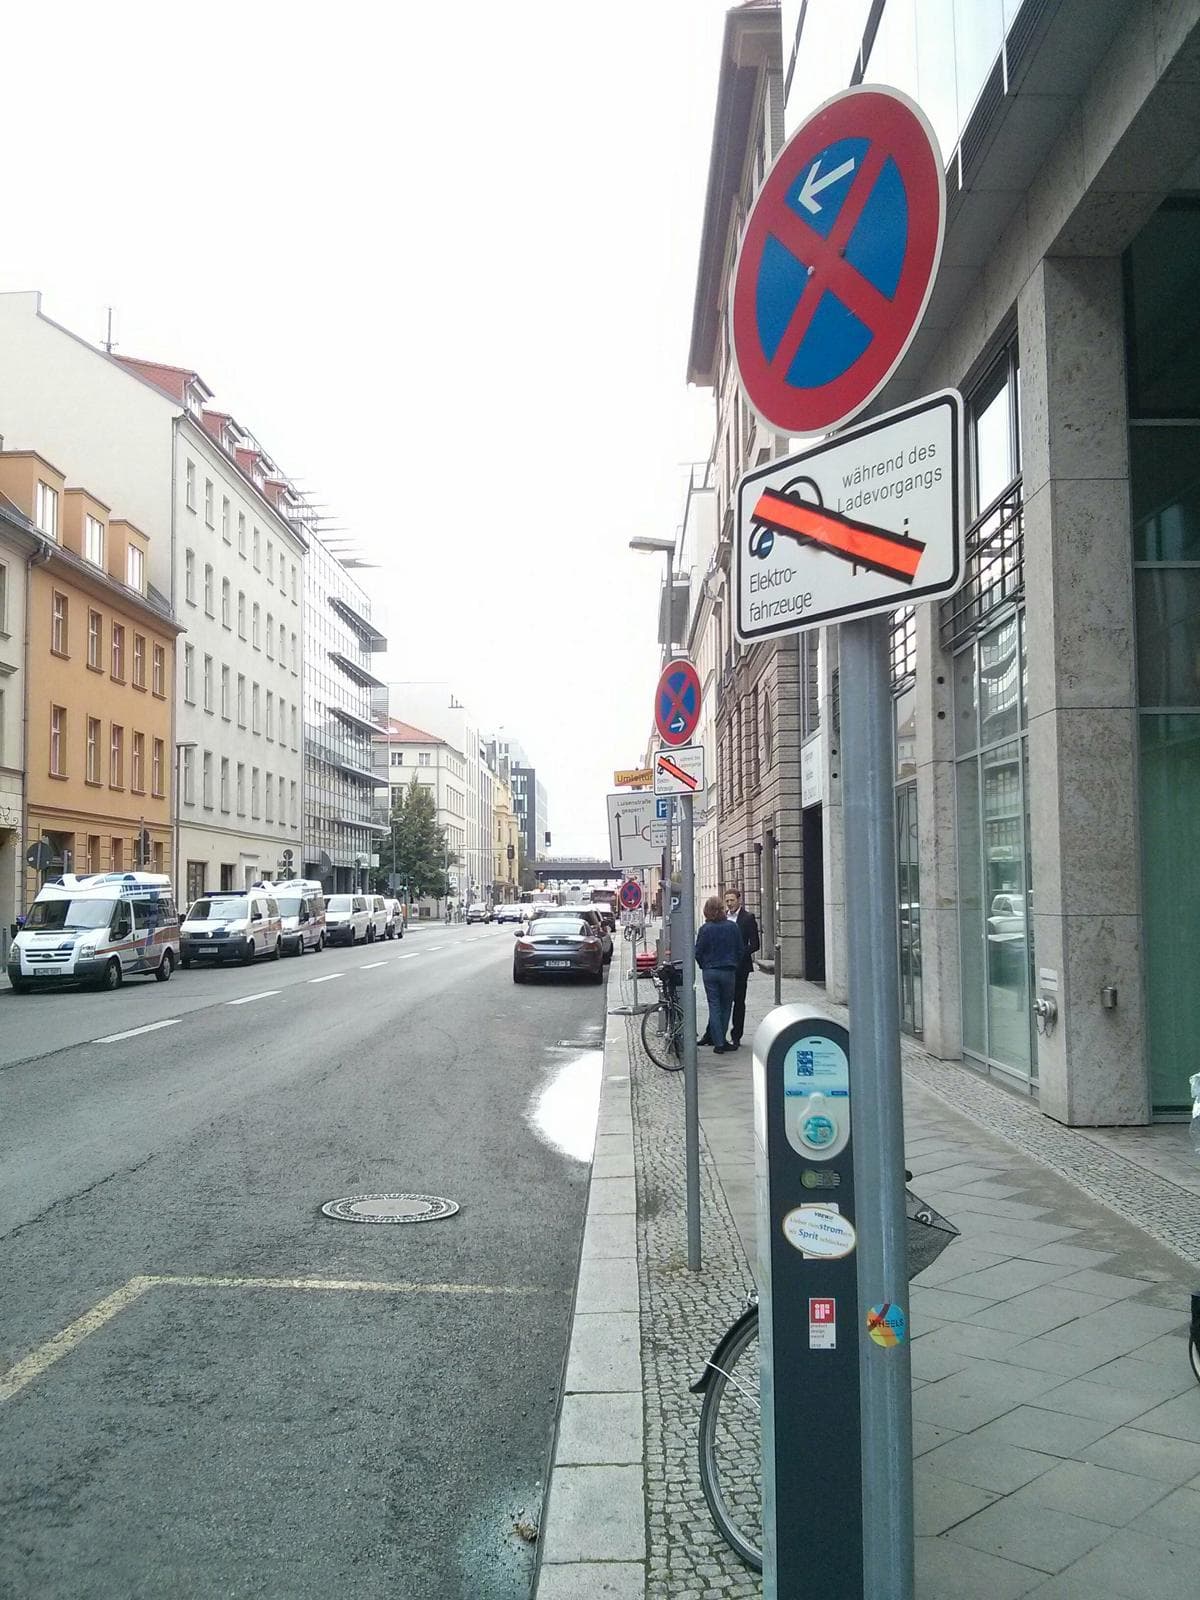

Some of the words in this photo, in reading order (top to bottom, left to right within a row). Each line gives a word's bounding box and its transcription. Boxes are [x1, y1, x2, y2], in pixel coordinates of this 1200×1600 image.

[842, 451, 903, 489] während
[909, 442, 937, 465] des
[837, 466, 943, 513] Ladevorgangs
[750, 569, 797, 594] Elektro-
[749, 591, 812, 622] fahrzeuge
[798, 1228, 819, 1241] Sprit
